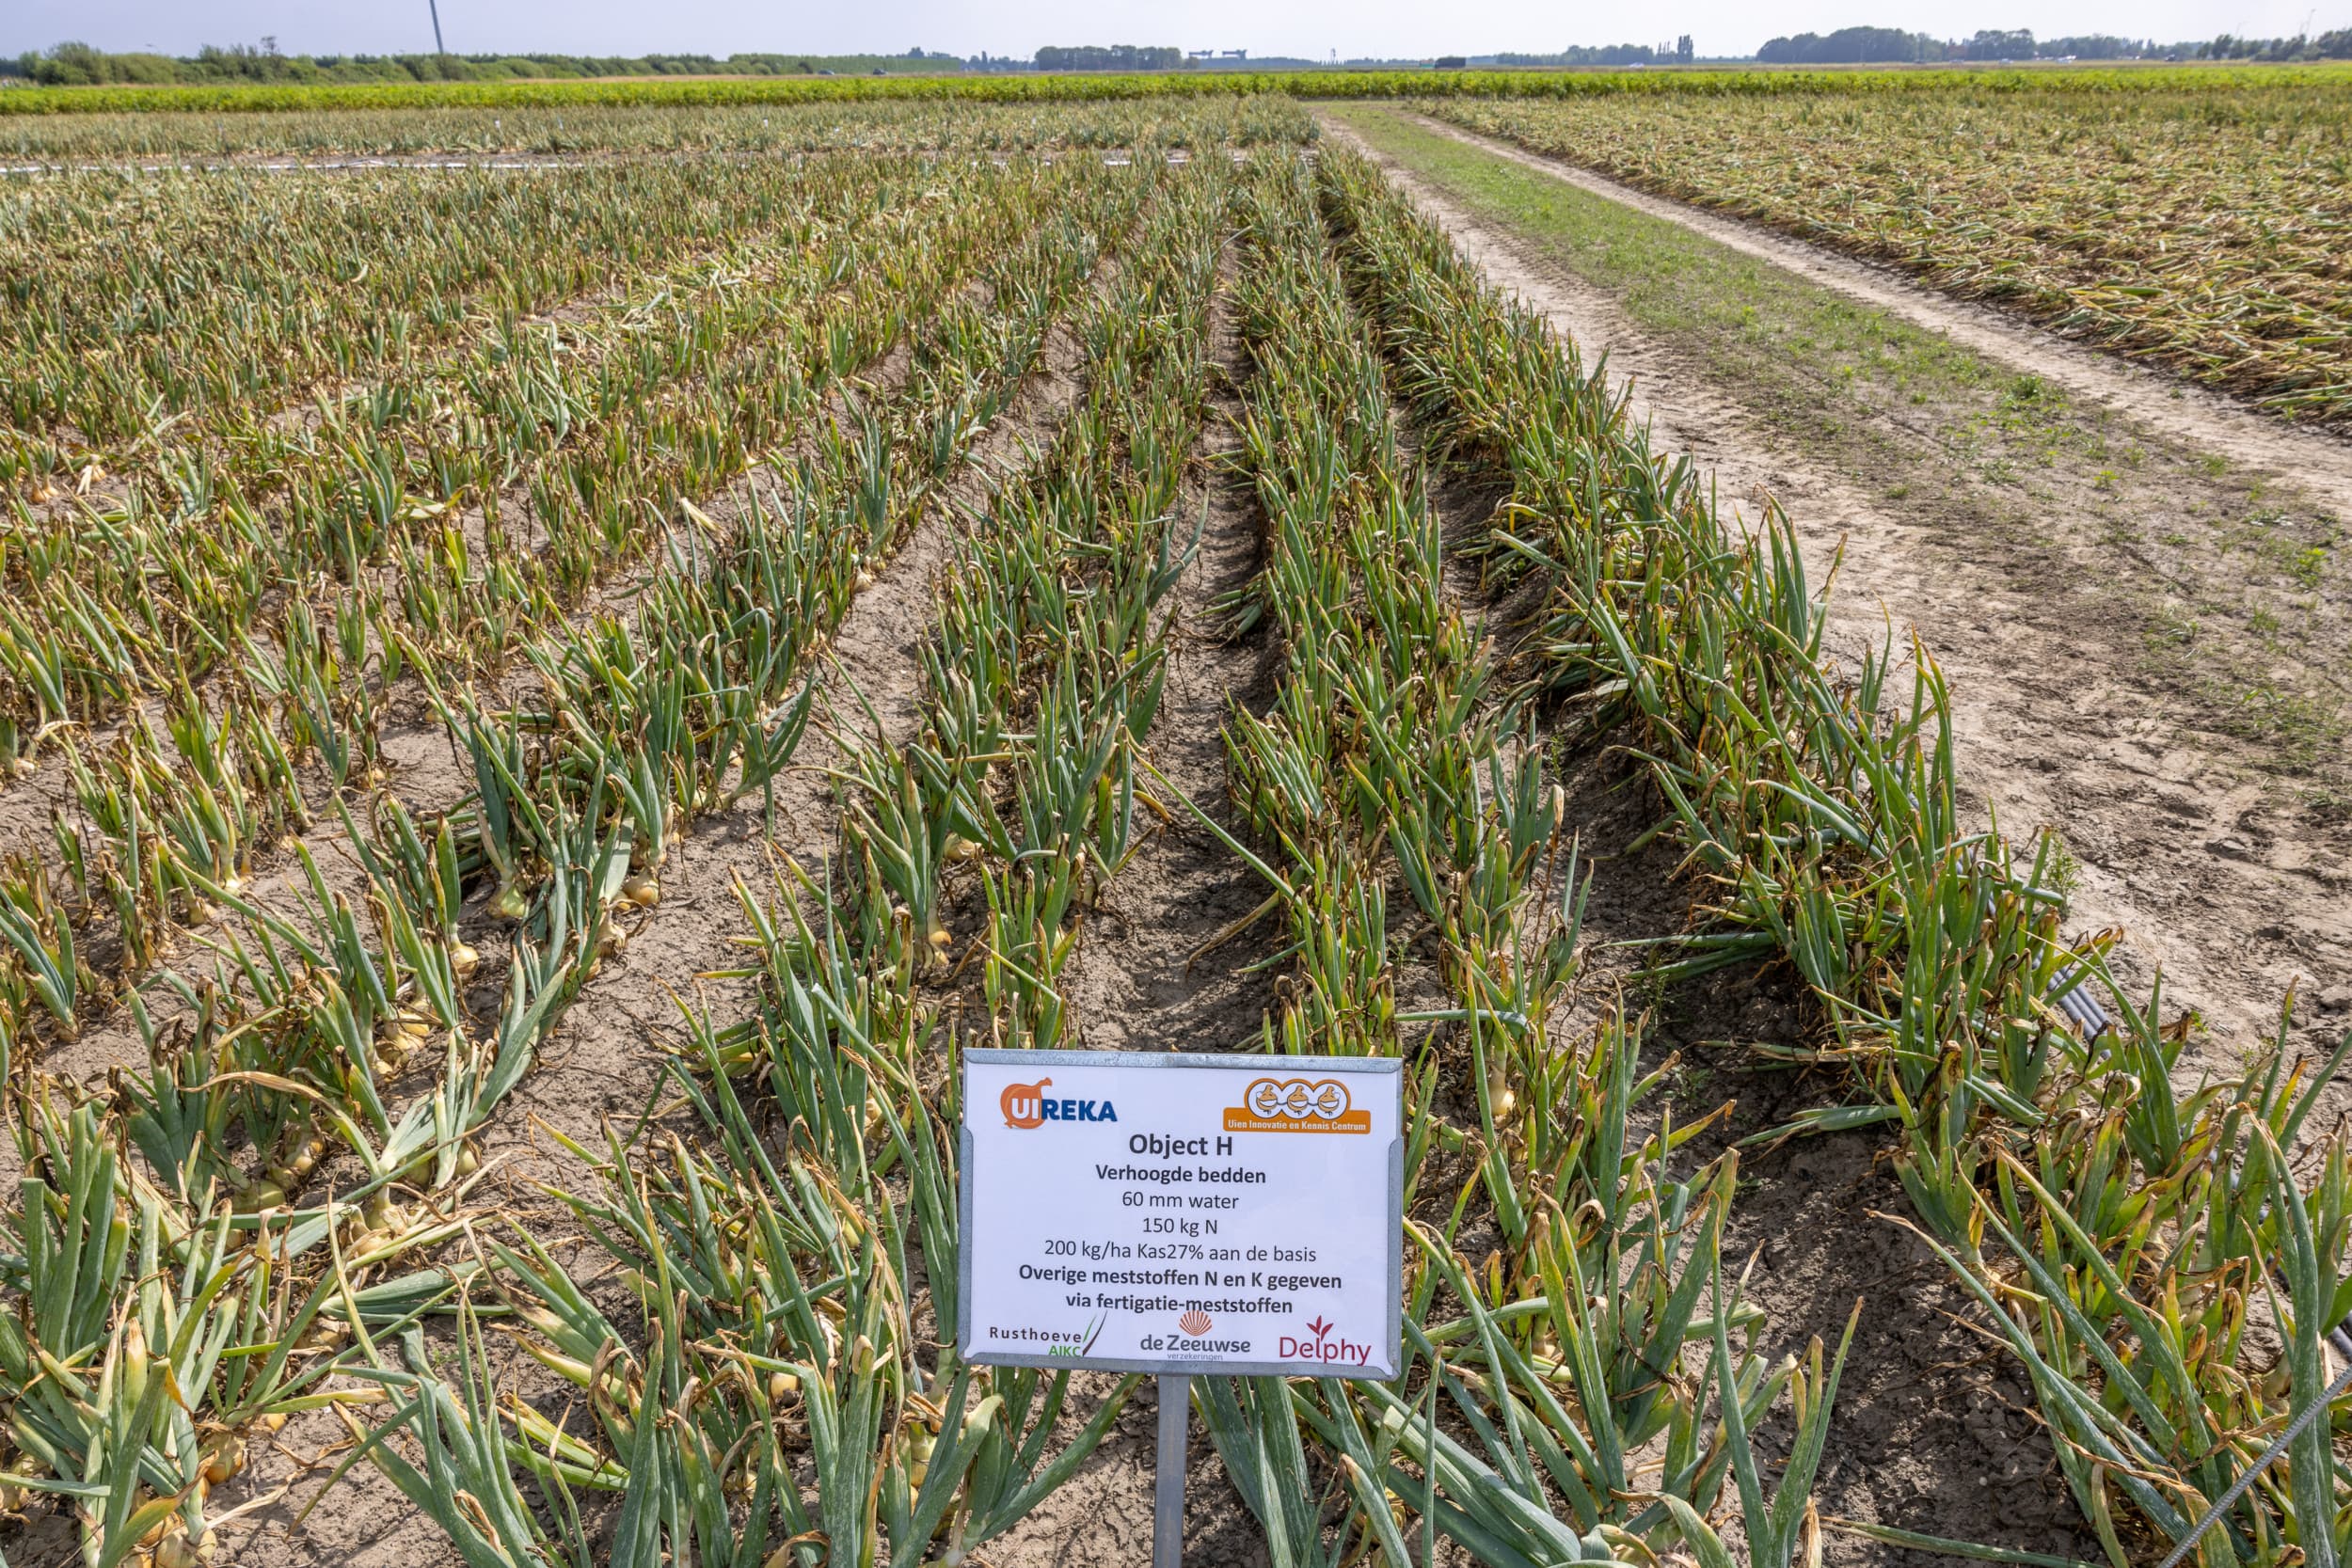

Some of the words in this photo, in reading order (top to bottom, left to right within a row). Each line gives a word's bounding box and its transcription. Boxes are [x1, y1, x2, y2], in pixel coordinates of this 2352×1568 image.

[1011, 1098, 1118, 1122] UIREKA
[1228, 1119, 1248, 1129] Uien
[1249, 1119, 1287, 1130] Innovatie
[1301, 1120, 1329, 1131] Kennis
[1331, 1121, 1366, 1132] Centrum
[1129, 1133, 1208, 1159] Object
[1216, 1136, 1232, 1156] H
[1096, 1164, 1193, 1183] Verhoogde
[1198, 1166, 1266, 1184] bedden
[1122, 1192, 1143, 1207] 60
[1150, 1196, 1183, 1208] mm
[1188, 1195, 1239, 1210] water
[1142, 1218, 1174, 1234] 150
[1180, 1218, 1200, 1238] kg
[1205, 1220, 1217, 1234] N
[1044, 1240, 1076, 1257] 200
[1082, 1241, 1132, 1260] kg/ha
[1137, 1243, 1203, 1260] Kas27%
[1209, 1248, 1241, 1261] aan
[1247, 1245, 1268, 1262] de
[1274, 1246, 1316, 1262] basis
[1019, 1264, 1087, 1285] Overige
[1092, 1269, 1200, 1286] meststoffen
[1205, 1270, 1218, 1286] N
[1223, 1274, 1246, 1287] en
[1251, 1272, 1263, 1287] K
[1267, 1274, 1343, 1291] gegeven
[1066, 1292, 1091, 1308] via
[1096, 1294, 1293, 1314] fertigatie-meststoffen
[989, 1326, 1082, 1342] Rusthoeve
[1140, 1334, 1163, 1351] de
[1167, 1335, 1251, 1353] Zeeuwse
[1048, 1345, 1082, 1357] AIKC
[1167, 1353, 1223, 1361] verzekeringen
[1279, 1336, 1372, 1366] Delphy
